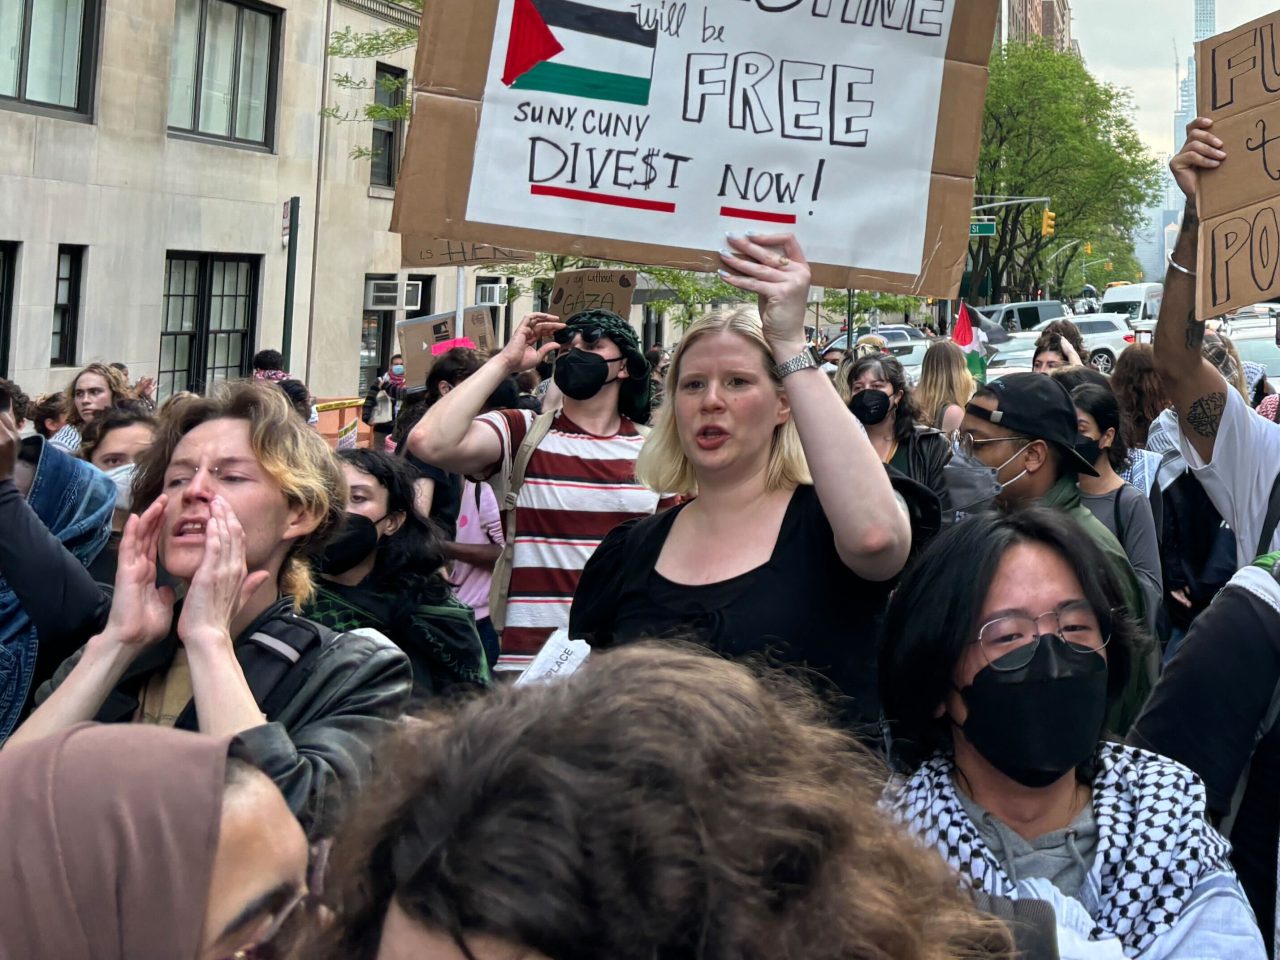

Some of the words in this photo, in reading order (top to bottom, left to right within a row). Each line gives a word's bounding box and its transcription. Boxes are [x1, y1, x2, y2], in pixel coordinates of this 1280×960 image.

[630, 0, 687, 38] will
[701, 6, 725, 43] be
[682, 52, 875, 147] FREE
[582, 108, 651, 142] CUNY
[528, 135, 693, 191] DIVE$T
[717, 158, 825, 215] NOW!
[971, 224, 979, 233] St
[562, 292, 615, 316] GAZA
